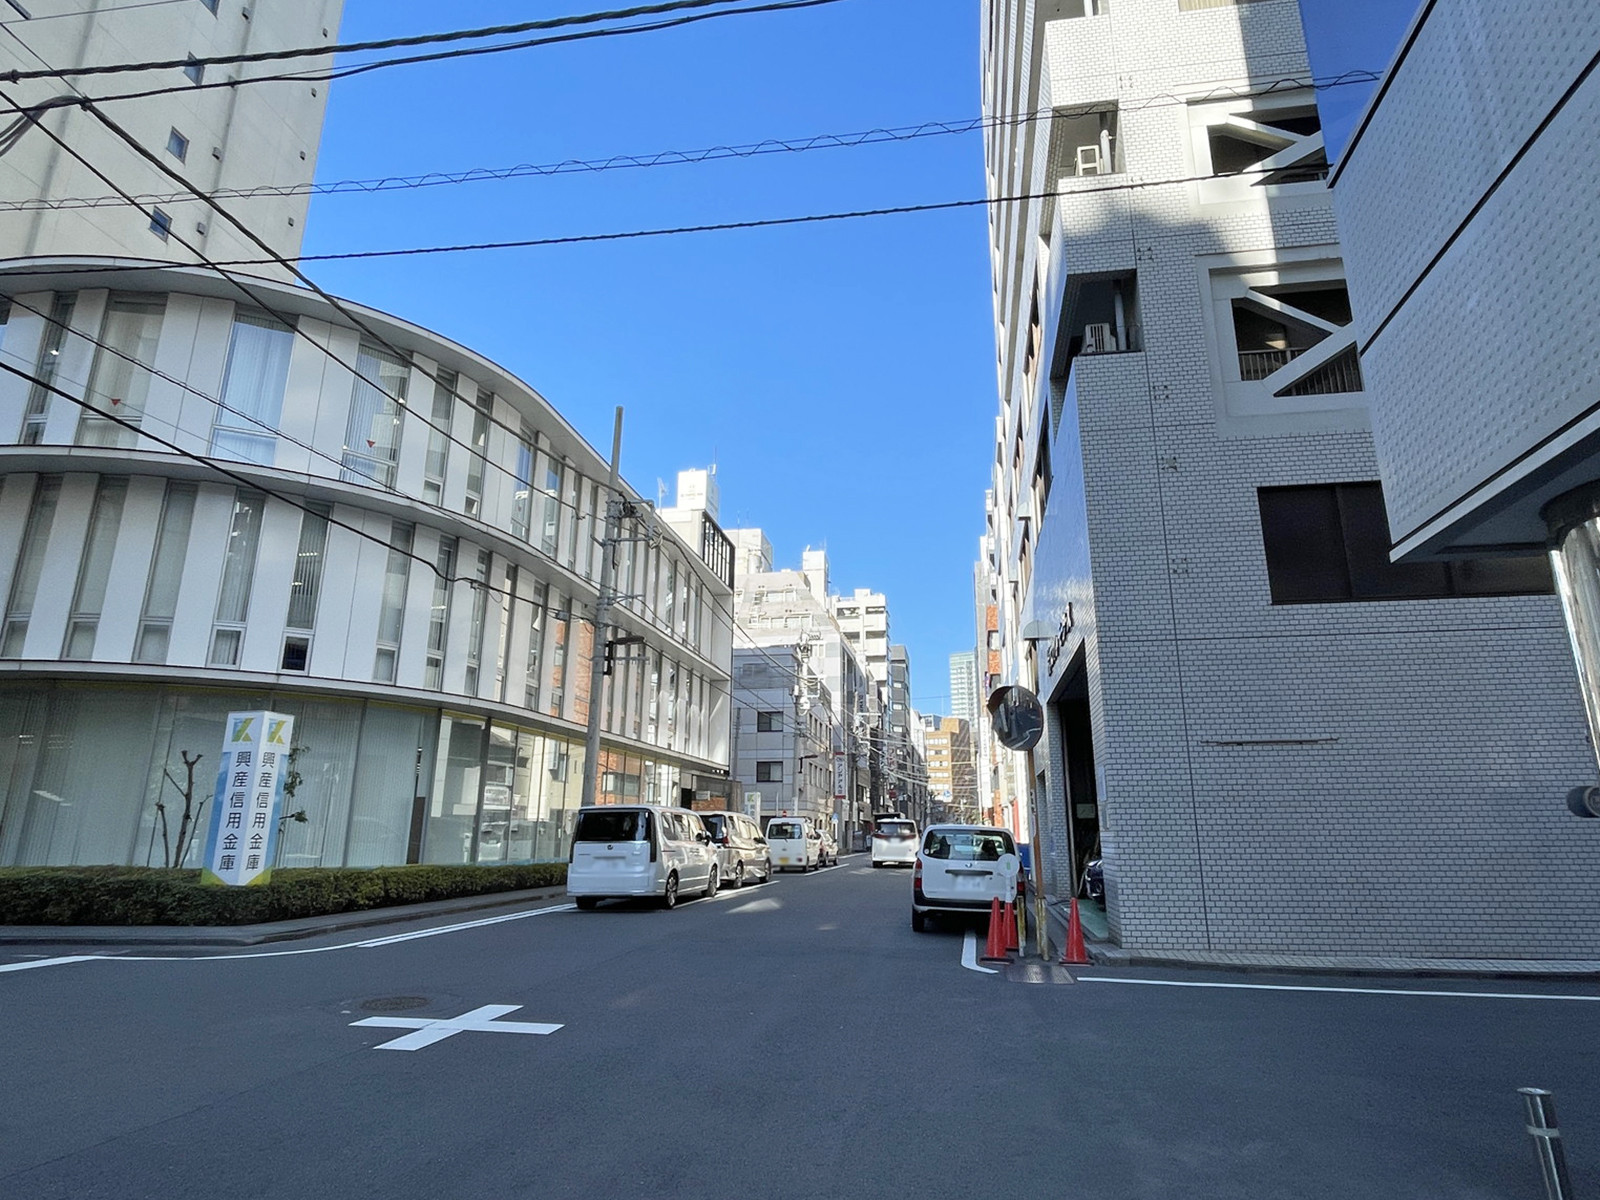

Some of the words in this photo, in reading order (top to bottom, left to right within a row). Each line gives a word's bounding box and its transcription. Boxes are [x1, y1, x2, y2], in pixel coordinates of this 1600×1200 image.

[219, 751, 251, 871] 興産信用金庫
[245, 751, 275, 870] 興産信用金庫
